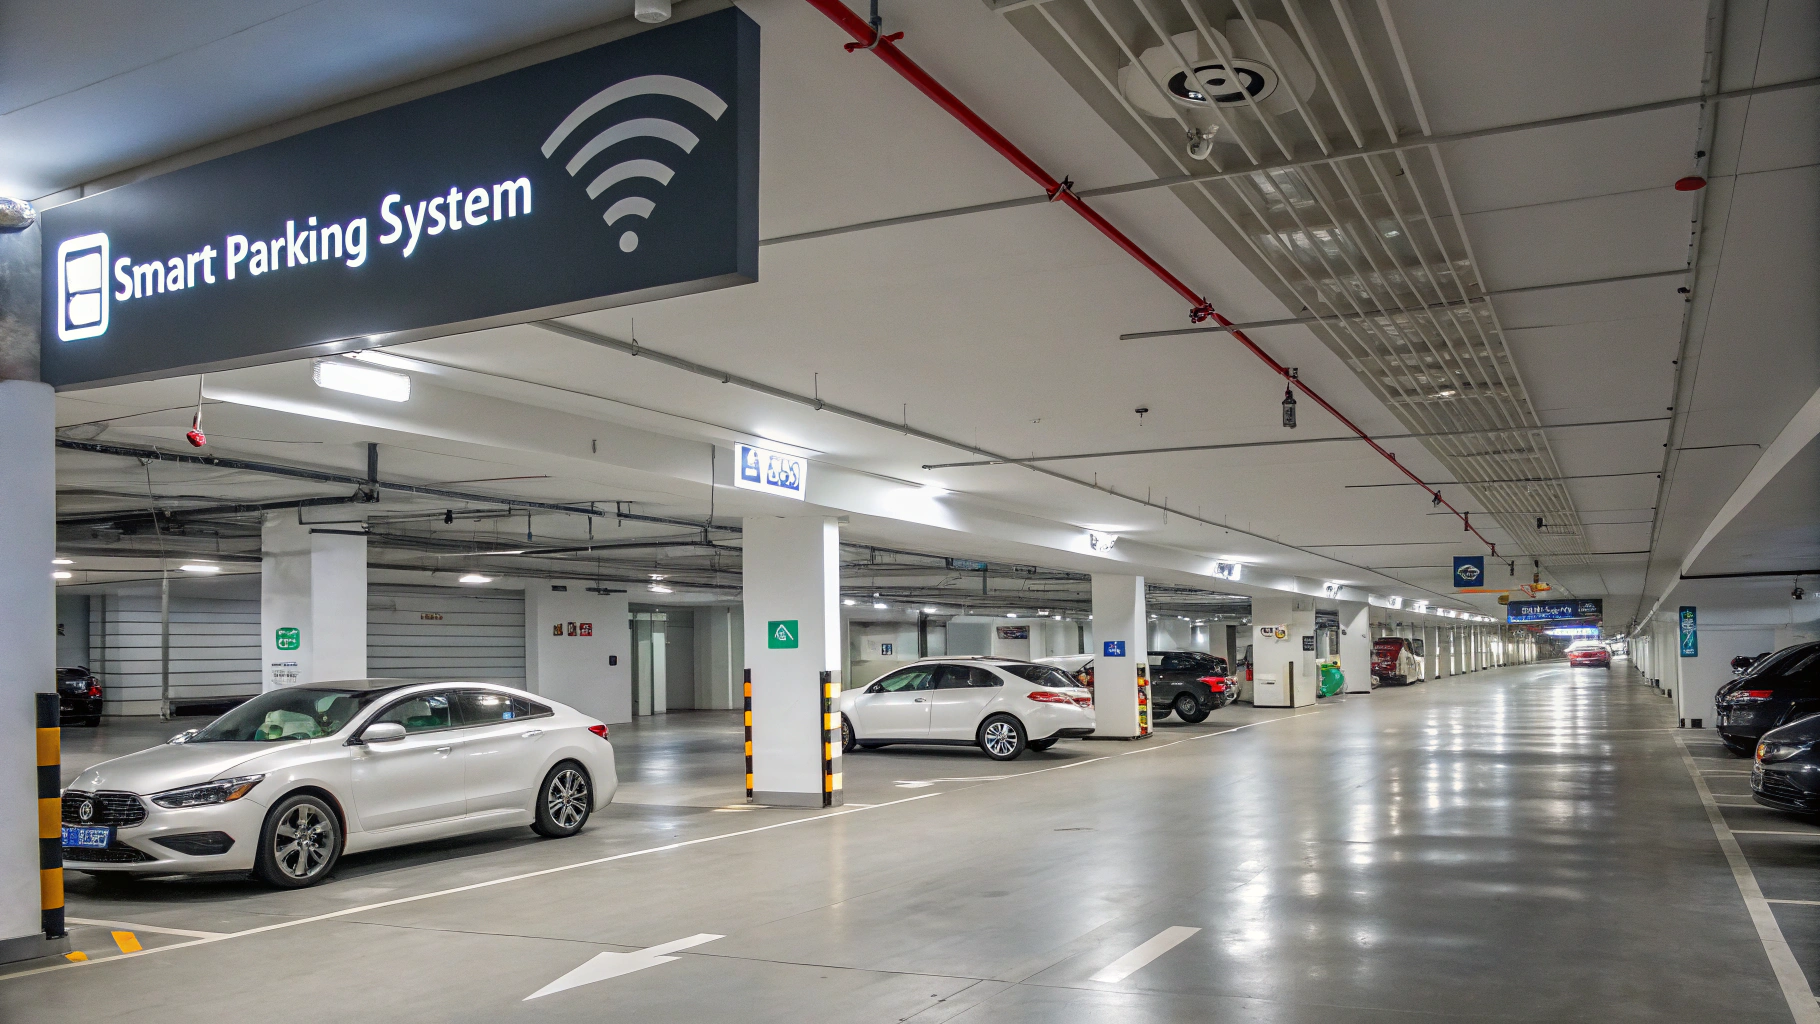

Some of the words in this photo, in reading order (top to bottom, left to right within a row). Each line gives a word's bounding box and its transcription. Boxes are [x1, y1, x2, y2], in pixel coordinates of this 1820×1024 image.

[114, 244, 218, 302] Smart
[226, 215, 368, 281] Parking
[379, 177, 532, 259] System
